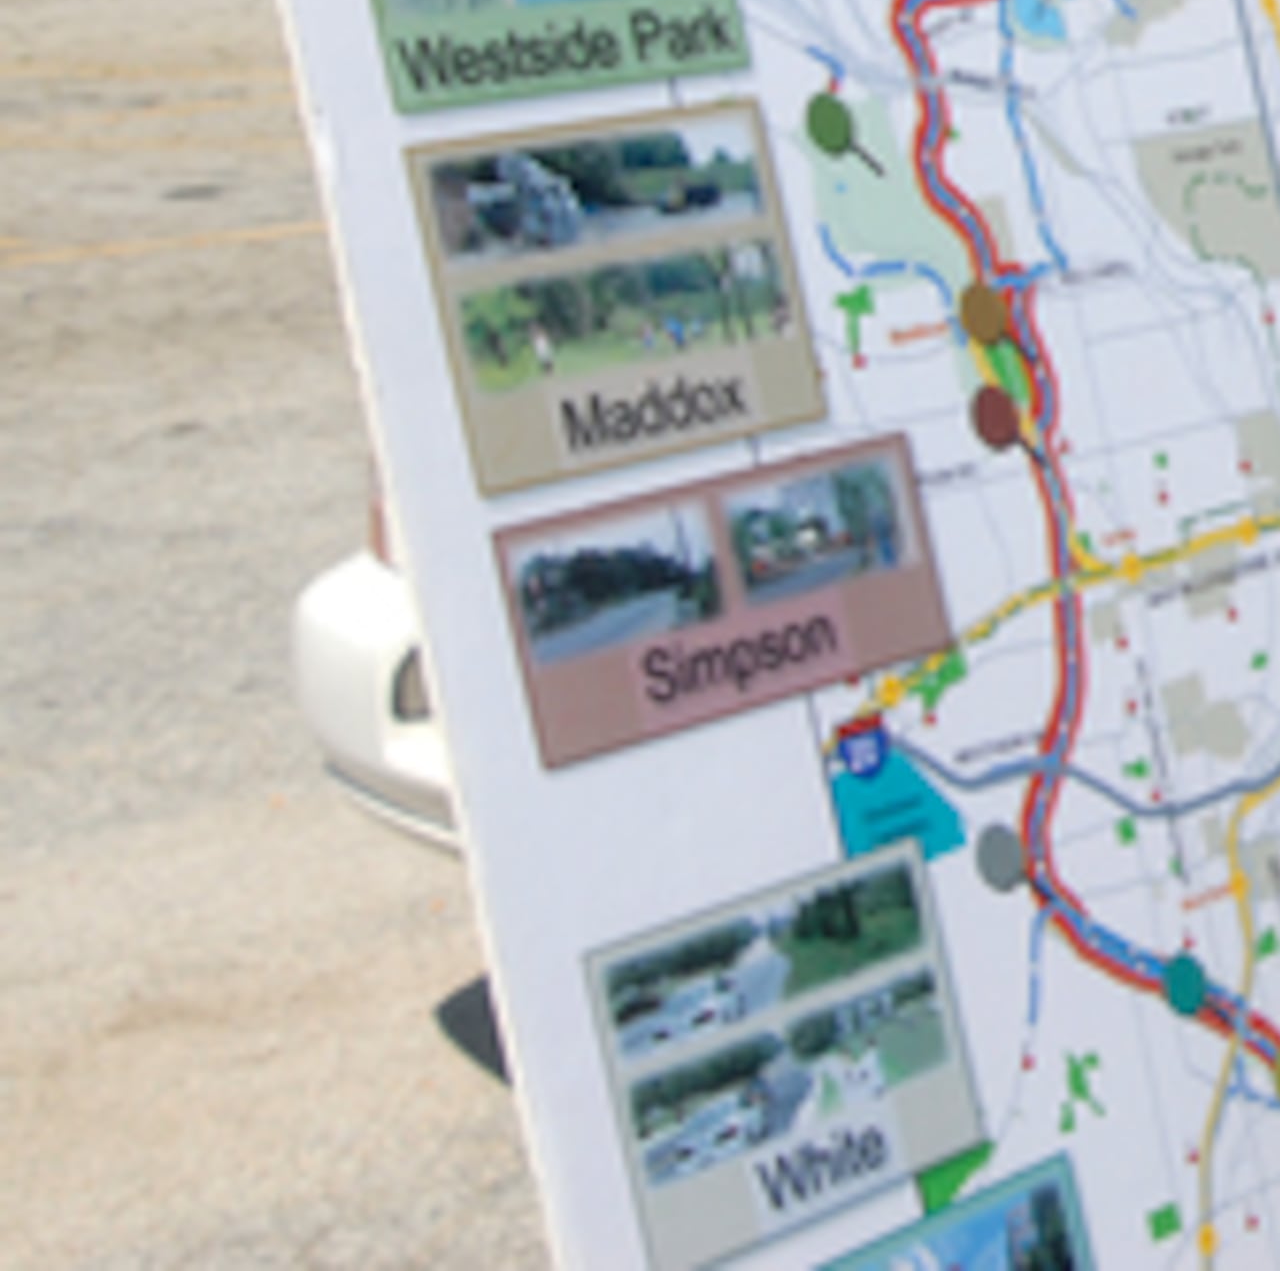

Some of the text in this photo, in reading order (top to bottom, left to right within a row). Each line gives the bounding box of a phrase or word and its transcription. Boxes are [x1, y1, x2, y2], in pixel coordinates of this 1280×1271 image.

[397, 5, 737, 92] Westside Park
[560, 375, 749, 453] Maddox
[643, 614, 840, 704] Simpson
[752, 1125, 890, 1212] White
